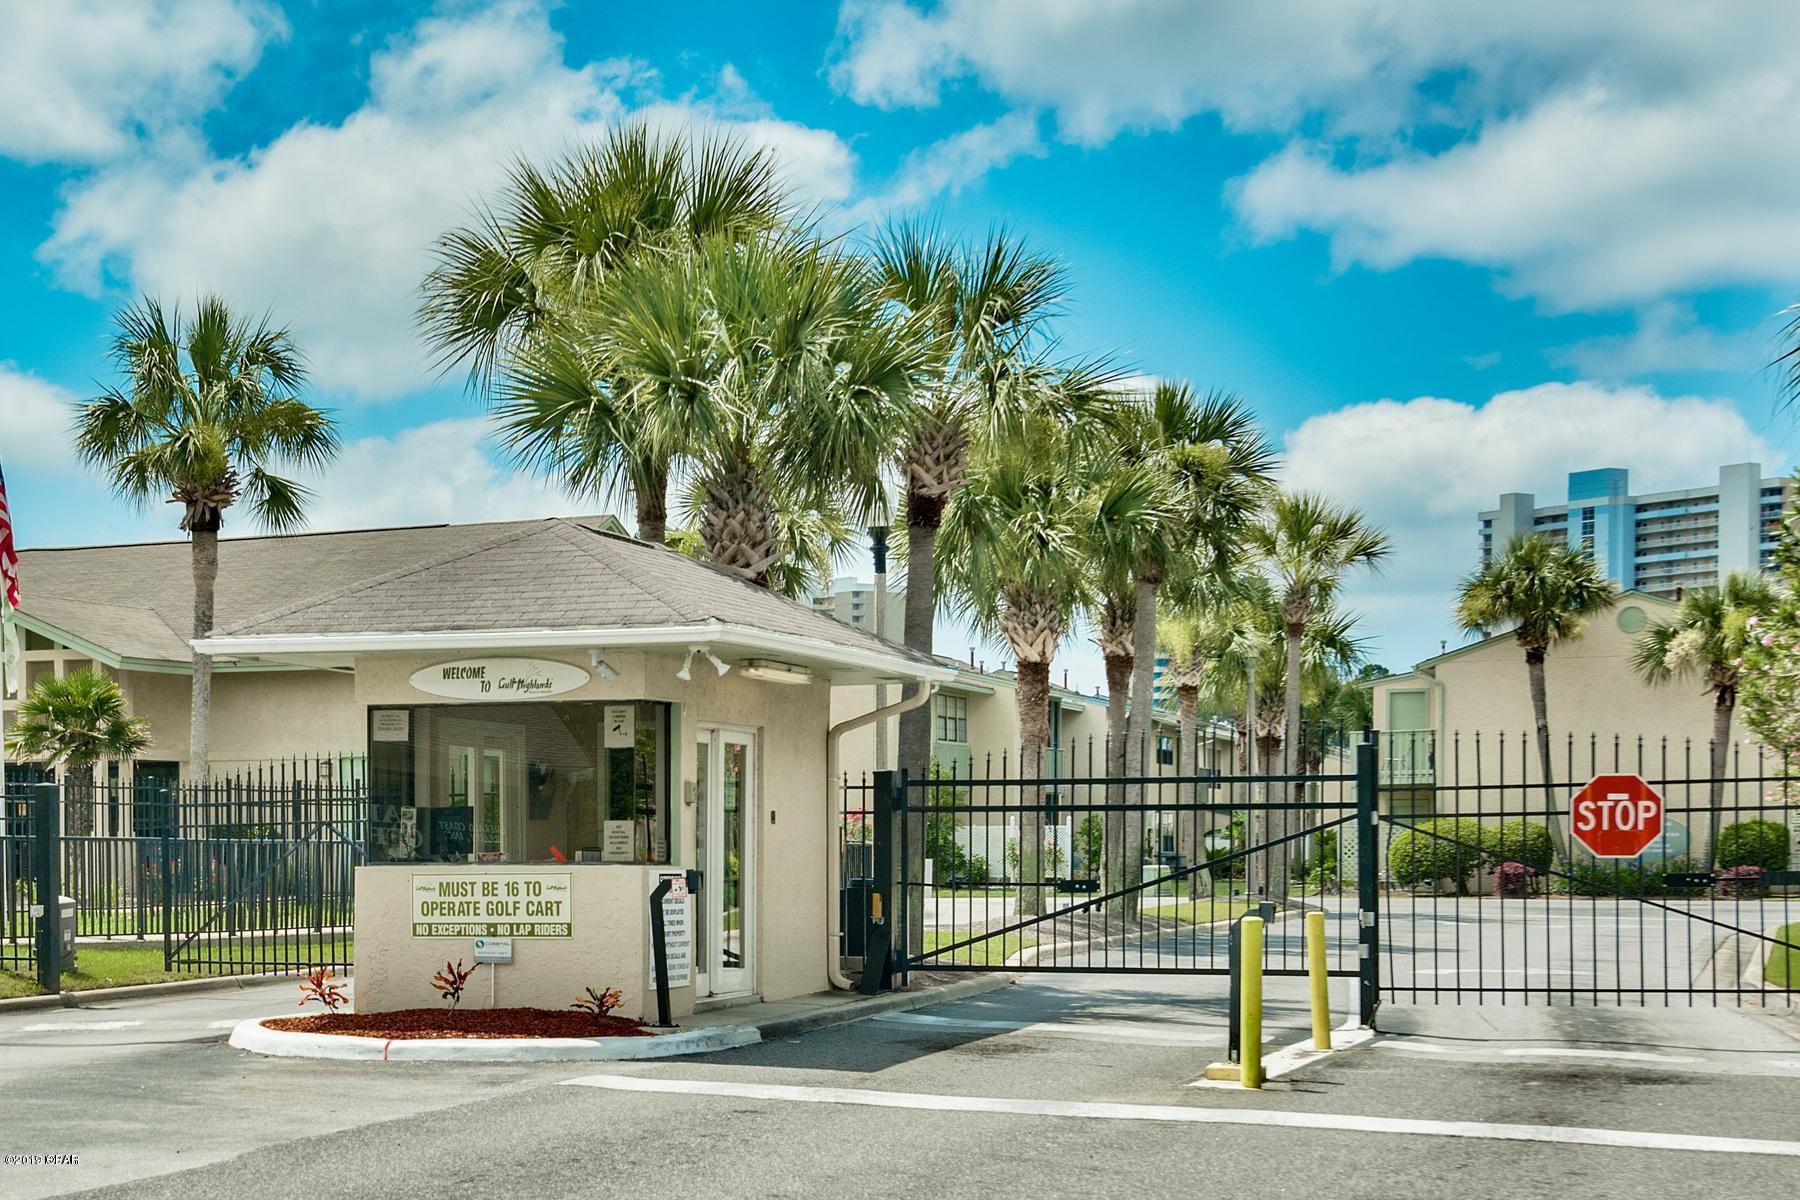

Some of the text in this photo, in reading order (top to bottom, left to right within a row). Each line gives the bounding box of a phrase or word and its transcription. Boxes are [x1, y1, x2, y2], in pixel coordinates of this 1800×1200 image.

[442, 666, 486, 680] WELCOME
[480, 680, 491, 693] TO
[516, 677, 553, 693] Highlands
[1577, 800, 1657, 831] STOP
[438, 881, 477, 897] MUST
[482, 881, 499, 897] BE
[504, 881, 519, 897] 16
[524, 880, 542, 897] TO
[421, 900, 562, 917] OPERATE GOLF CART
[415, 923, 568, 936] NO EXCEPTIONS NO LAP RIDERS
